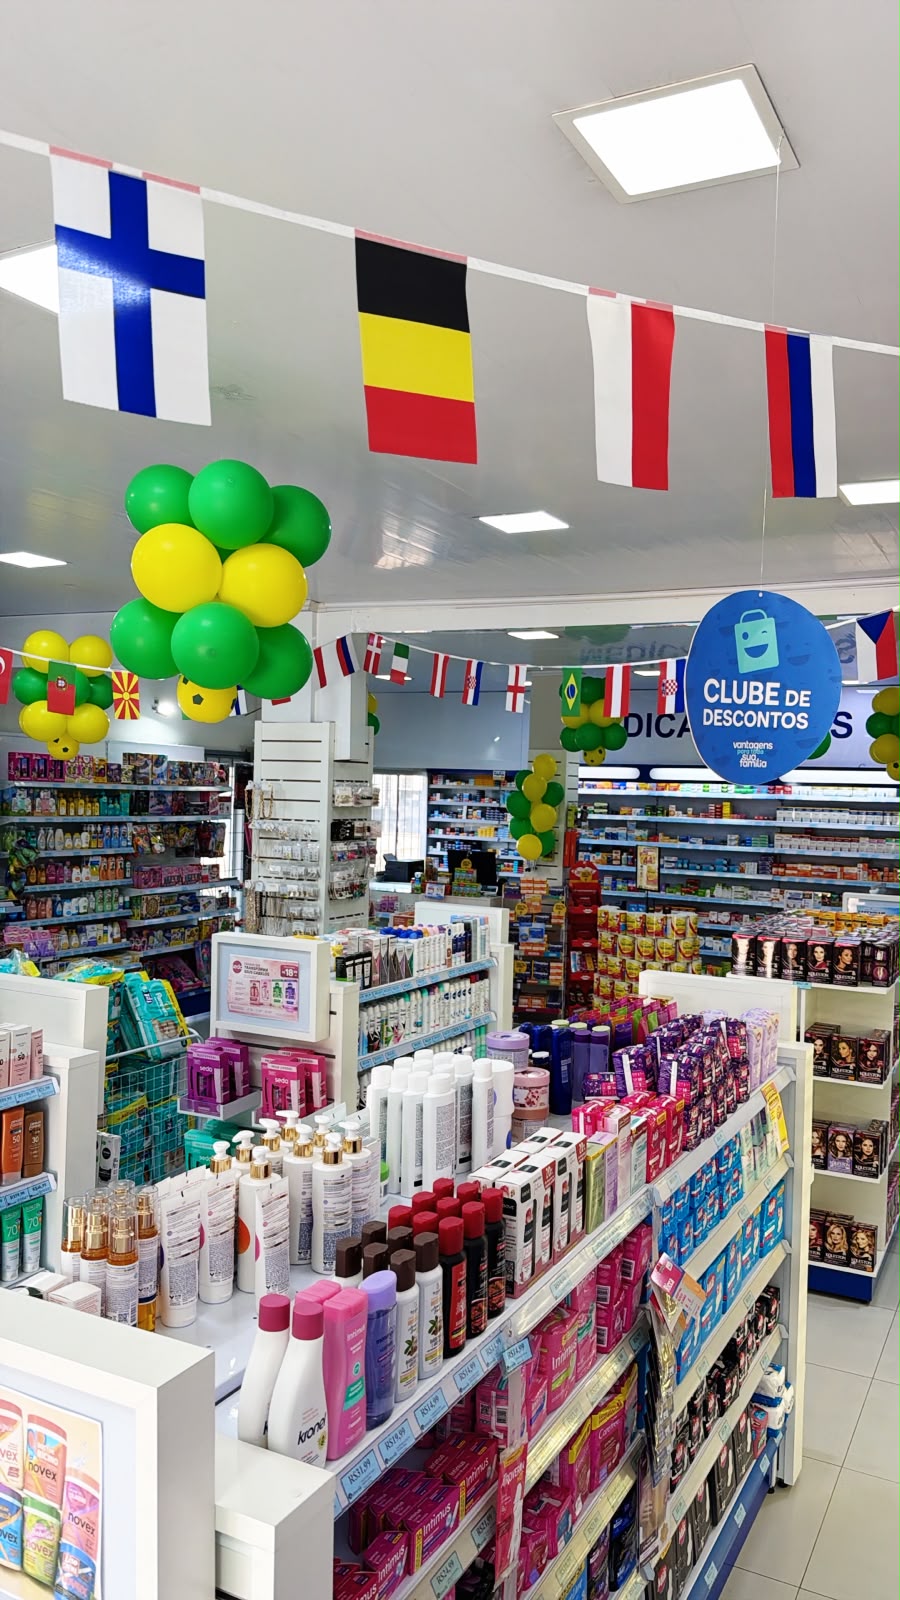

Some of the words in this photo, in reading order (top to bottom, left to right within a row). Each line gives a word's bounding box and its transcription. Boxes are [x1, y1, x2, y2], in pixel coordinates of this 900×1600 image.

[703, 678, 781, 706] CLUBE
[785, 690, 811, 707] DE
[703, 709, 809, 729] DESCONTOS
[733, 741, 773, 751] vantagens
[275, 1077, 289, 1085] seda
[12, 1134, 20, 1144] 50
[7, 1224, 18, 1238] 70
[28, 1216, 39, 1230] 70
[420, 1395, 440, 1418] R$14,99
[384, 1426, 407, 1451] R$19,99
[0, 1447, 18, 1462] vex
[28, 1461, 58, 1482] novex
[347, 1457, 371, 1486] R$31,99
[465, 1457, 489, 1488] Intimus
[68, 1512, 96, 1537] novex
[423, 1502, 451, 1536] Intimus
[25, 1540, 54, 1558] novex
[378, 1544, 405, 1582] Intimus
